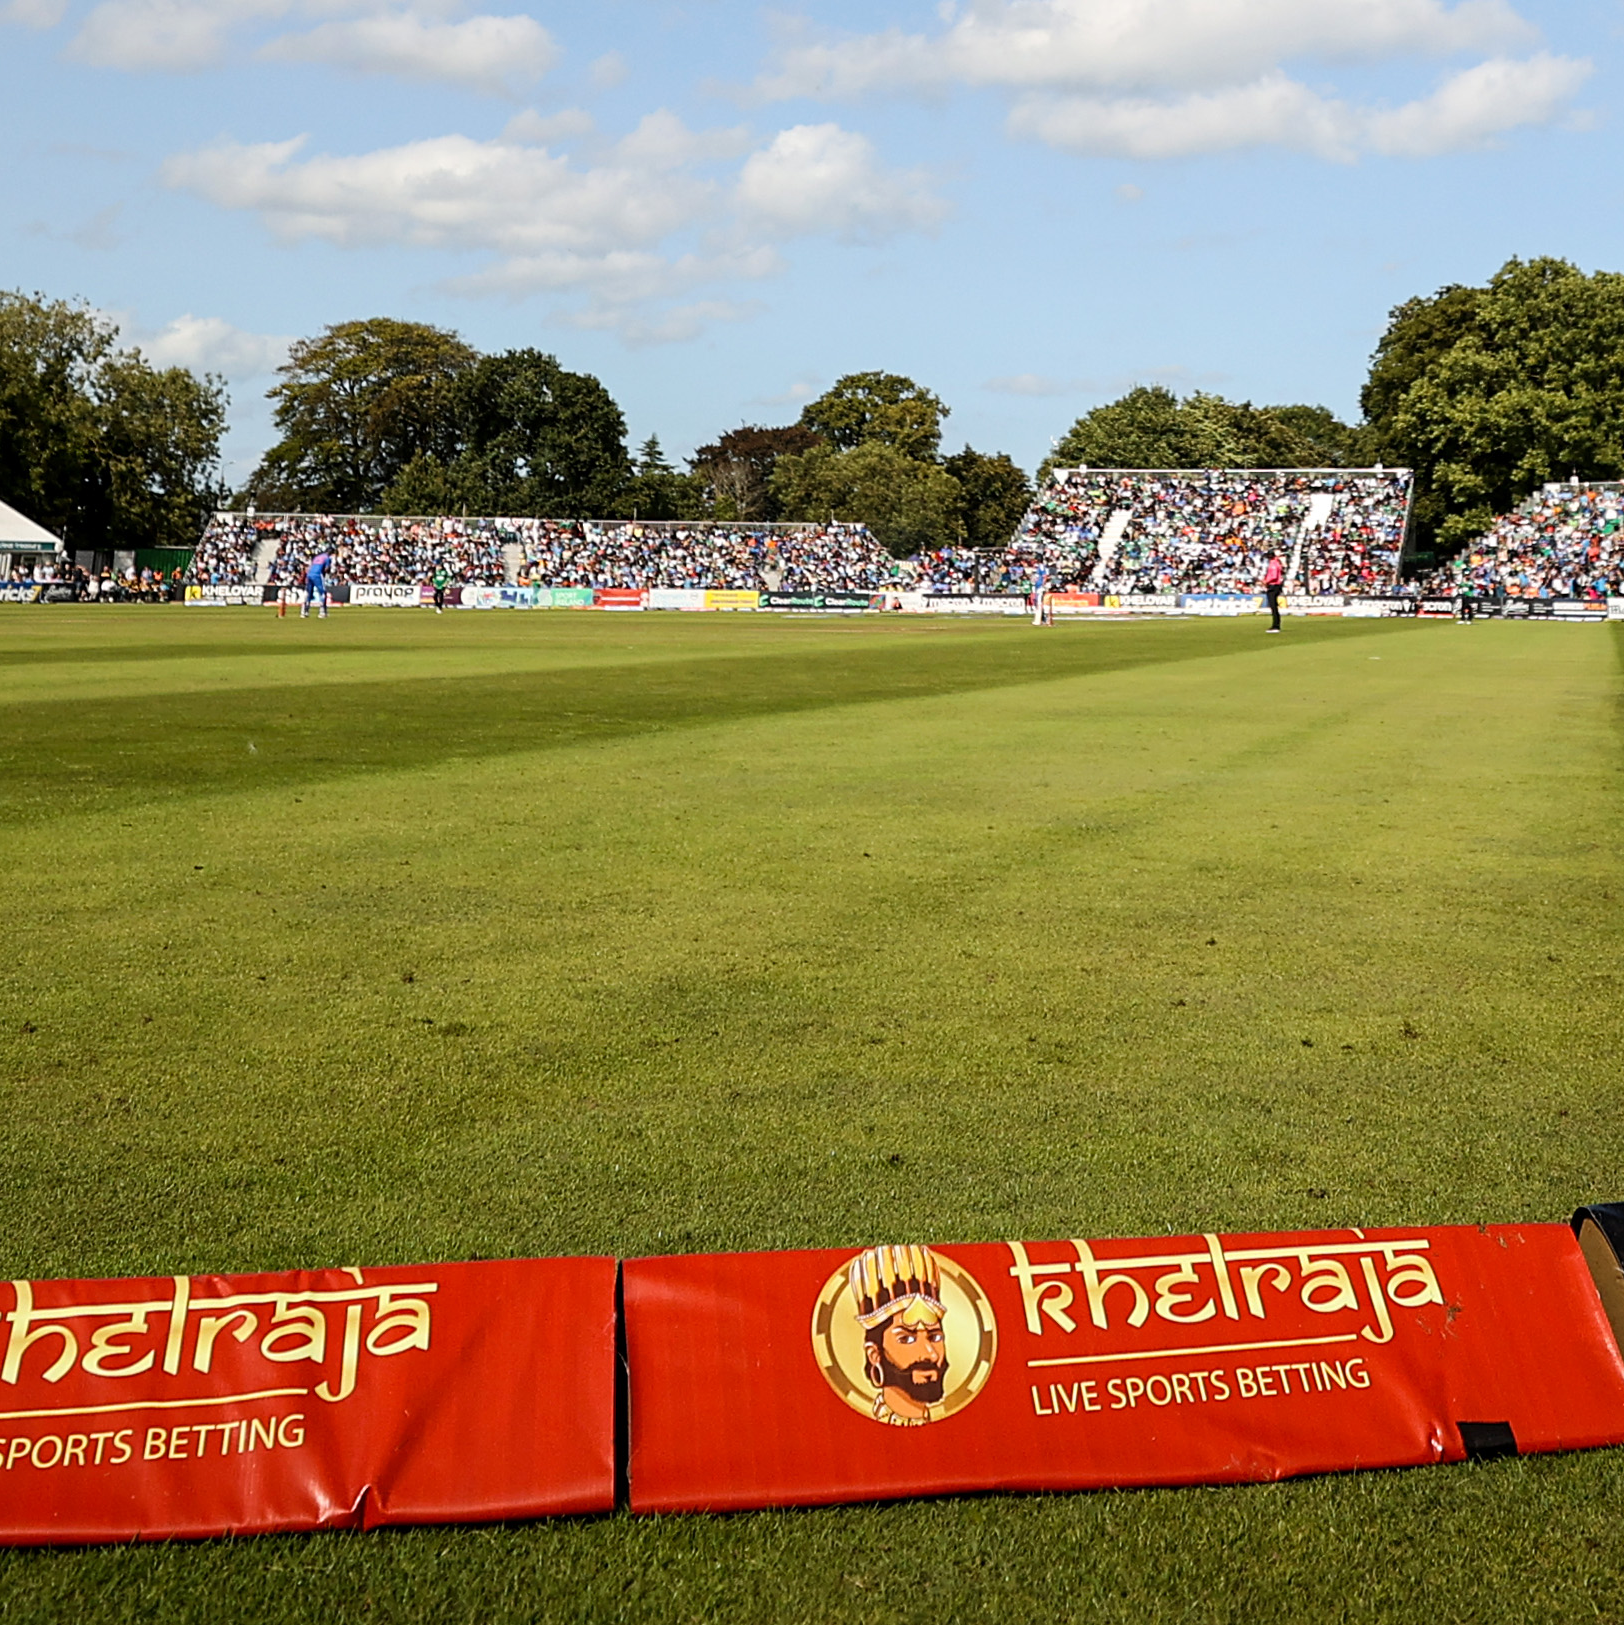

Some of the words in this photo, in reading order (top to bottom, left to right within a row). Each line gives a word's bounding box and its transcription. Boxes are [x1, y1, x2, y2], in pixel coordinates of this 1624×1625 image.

[201, 584, 265, 597] KHELOYAR
[928, 597, 969, 608] macron
[984, 597, 1025, 608] macron
[1120, 595, 1176, 607] KHELOYAR
[1287, 595, 1344, 607] KHELOYAR
[1009, 1227, 1444, 1344] khelraja
[1031, 1372, 1101, 1416] LIVE
[1109, 1367, 1231, 1409] SPORTS
[1236, 1357, 1371, 1402] BETTING
[143, 1413, 307, 1461] BETTING
